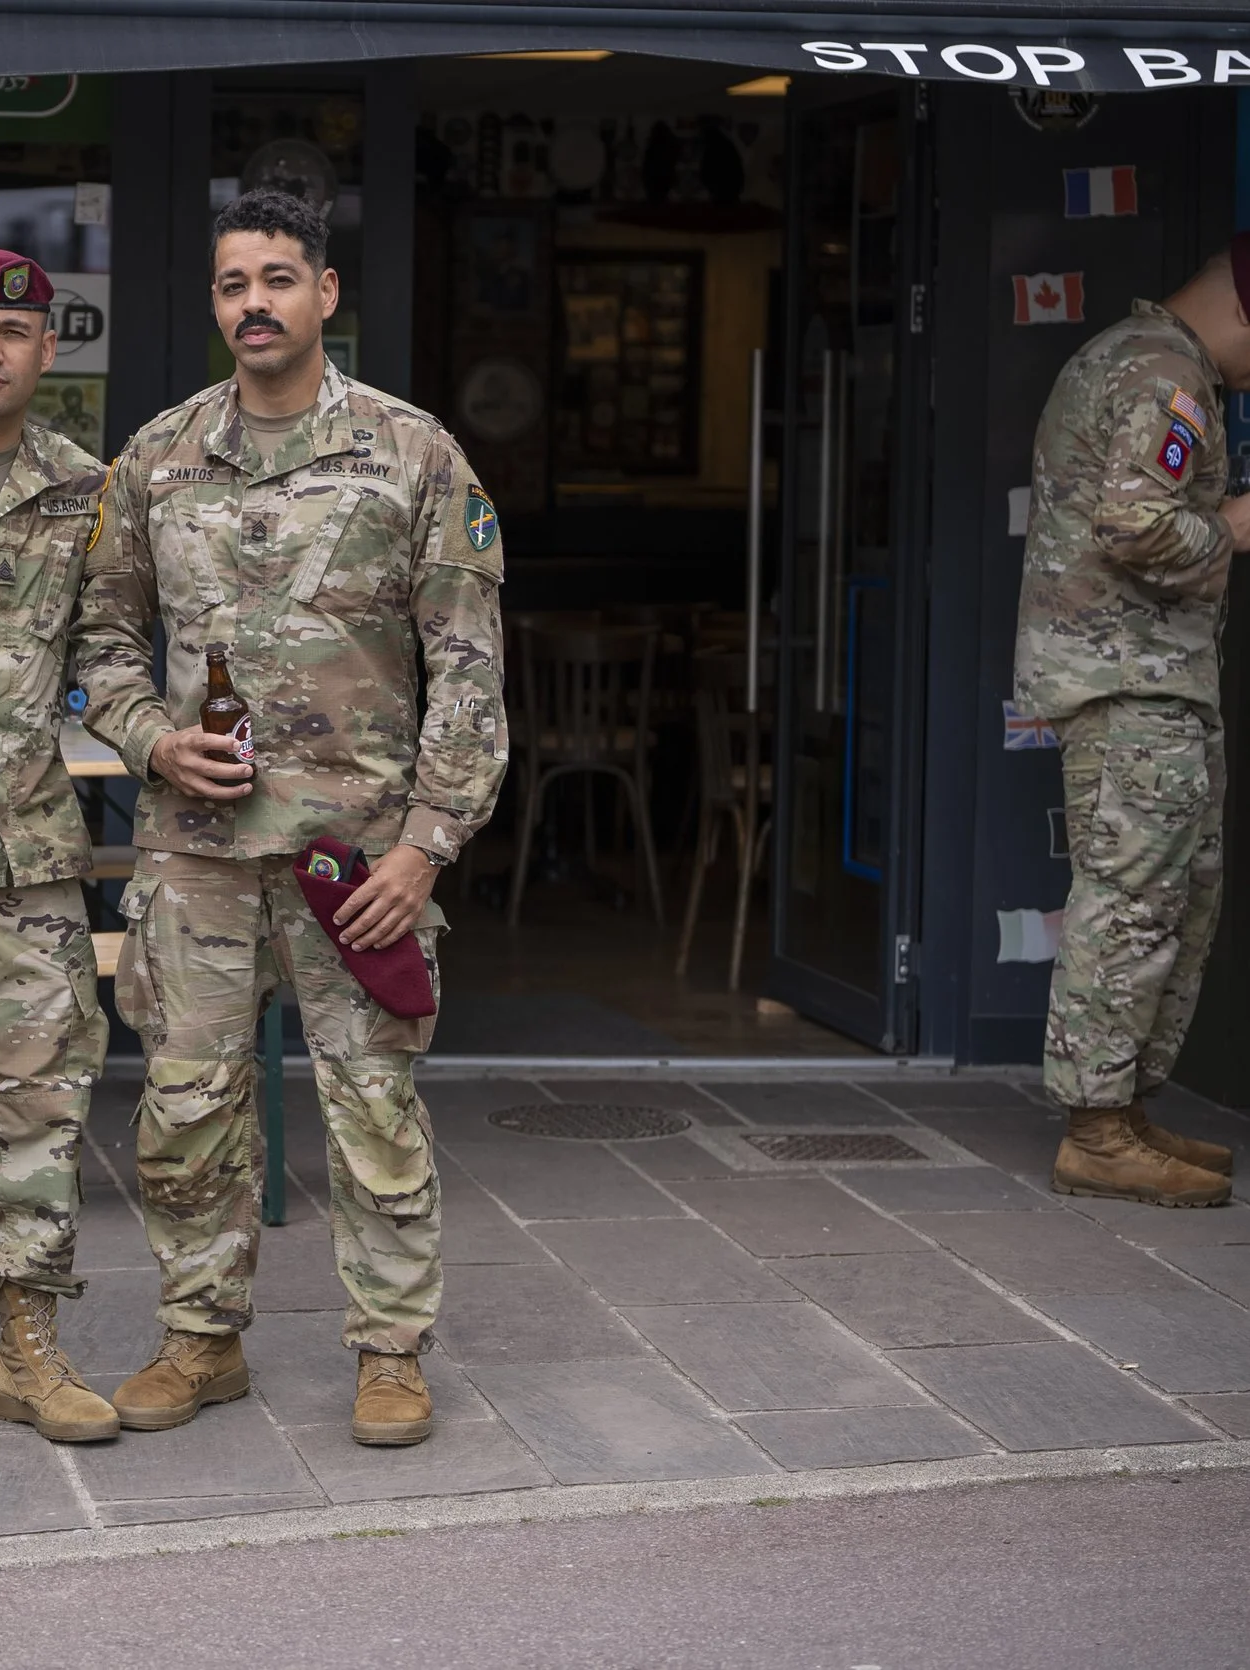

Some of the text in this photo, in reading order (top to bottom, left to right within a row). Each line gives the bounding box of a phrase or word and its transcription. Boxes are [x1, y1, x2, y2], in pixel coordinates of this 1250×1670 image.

[800, 40, 1086, 87] STOP
[166, 467, 215, 482] SANTOS
[320, 460, 391, 479] U.S. ARMY
